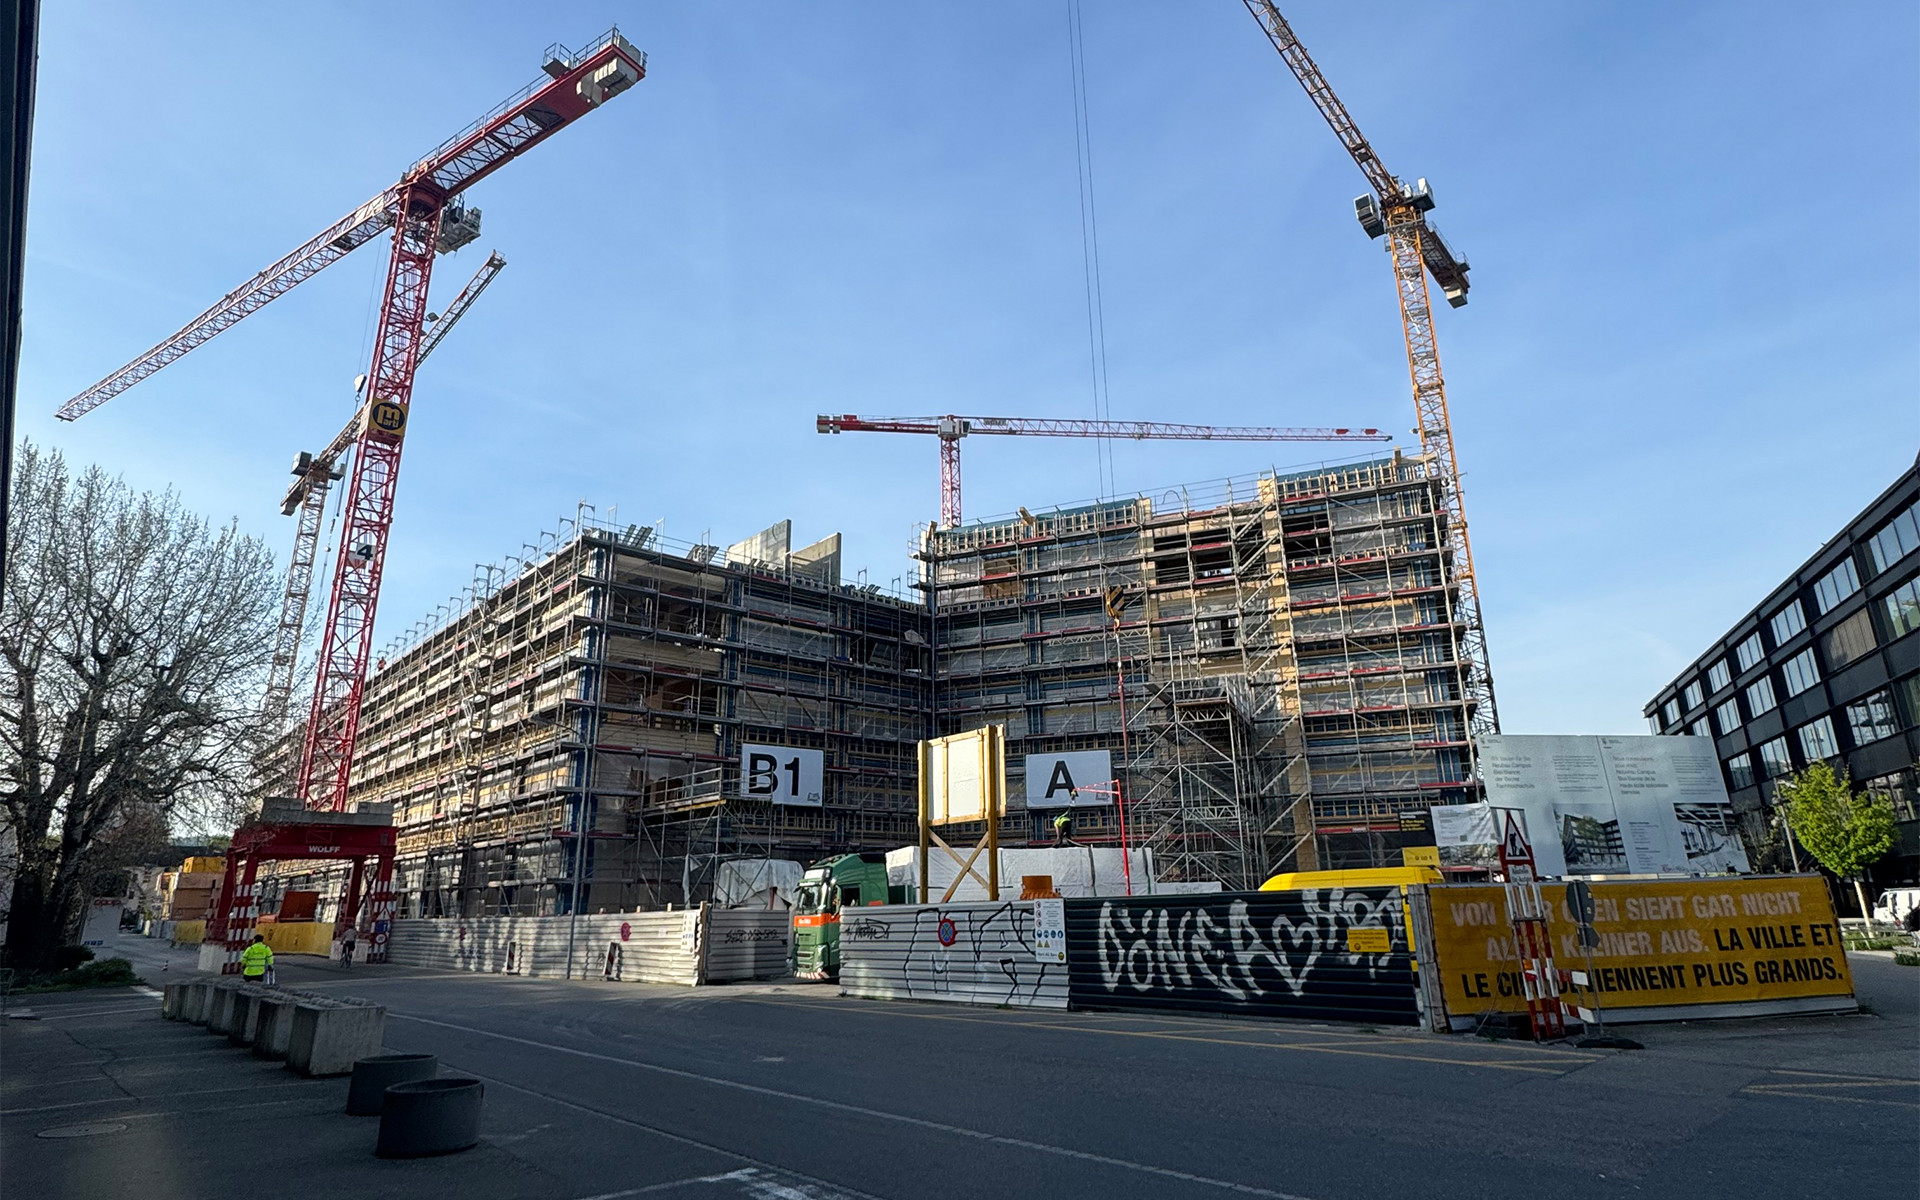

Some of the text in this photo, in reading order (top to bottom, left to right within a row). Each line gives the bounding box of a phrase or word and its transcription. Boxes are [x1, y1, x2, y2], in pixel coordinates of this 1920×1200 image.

[357, 545, 373, 560] 4
[749, 753, 799, 796] B1
[1045, 760, 1079, 798] A
[309, 845, 341, 853] WOLFF
[1451, 902, 1496, 927] VON
[1561, 898, 1620, 924] OEN
[1626, 896, 1685, 922] SIEHT
[1692, 894, 1737, 919] GAR
[1740, 891, 1802, 916] NICHT
[1661, 928, 1709, 954] AUS.
[1714, 928, 1744, 951] LA
[1747, 925, 1806, 949] VILLE
[1809, 924, 1835, 946] ET
[1462, 973, 1491, 998] LE
[1692, 961, 1748, 987] PLUS
[1754, 957, 1843, 984] GRANDS.
